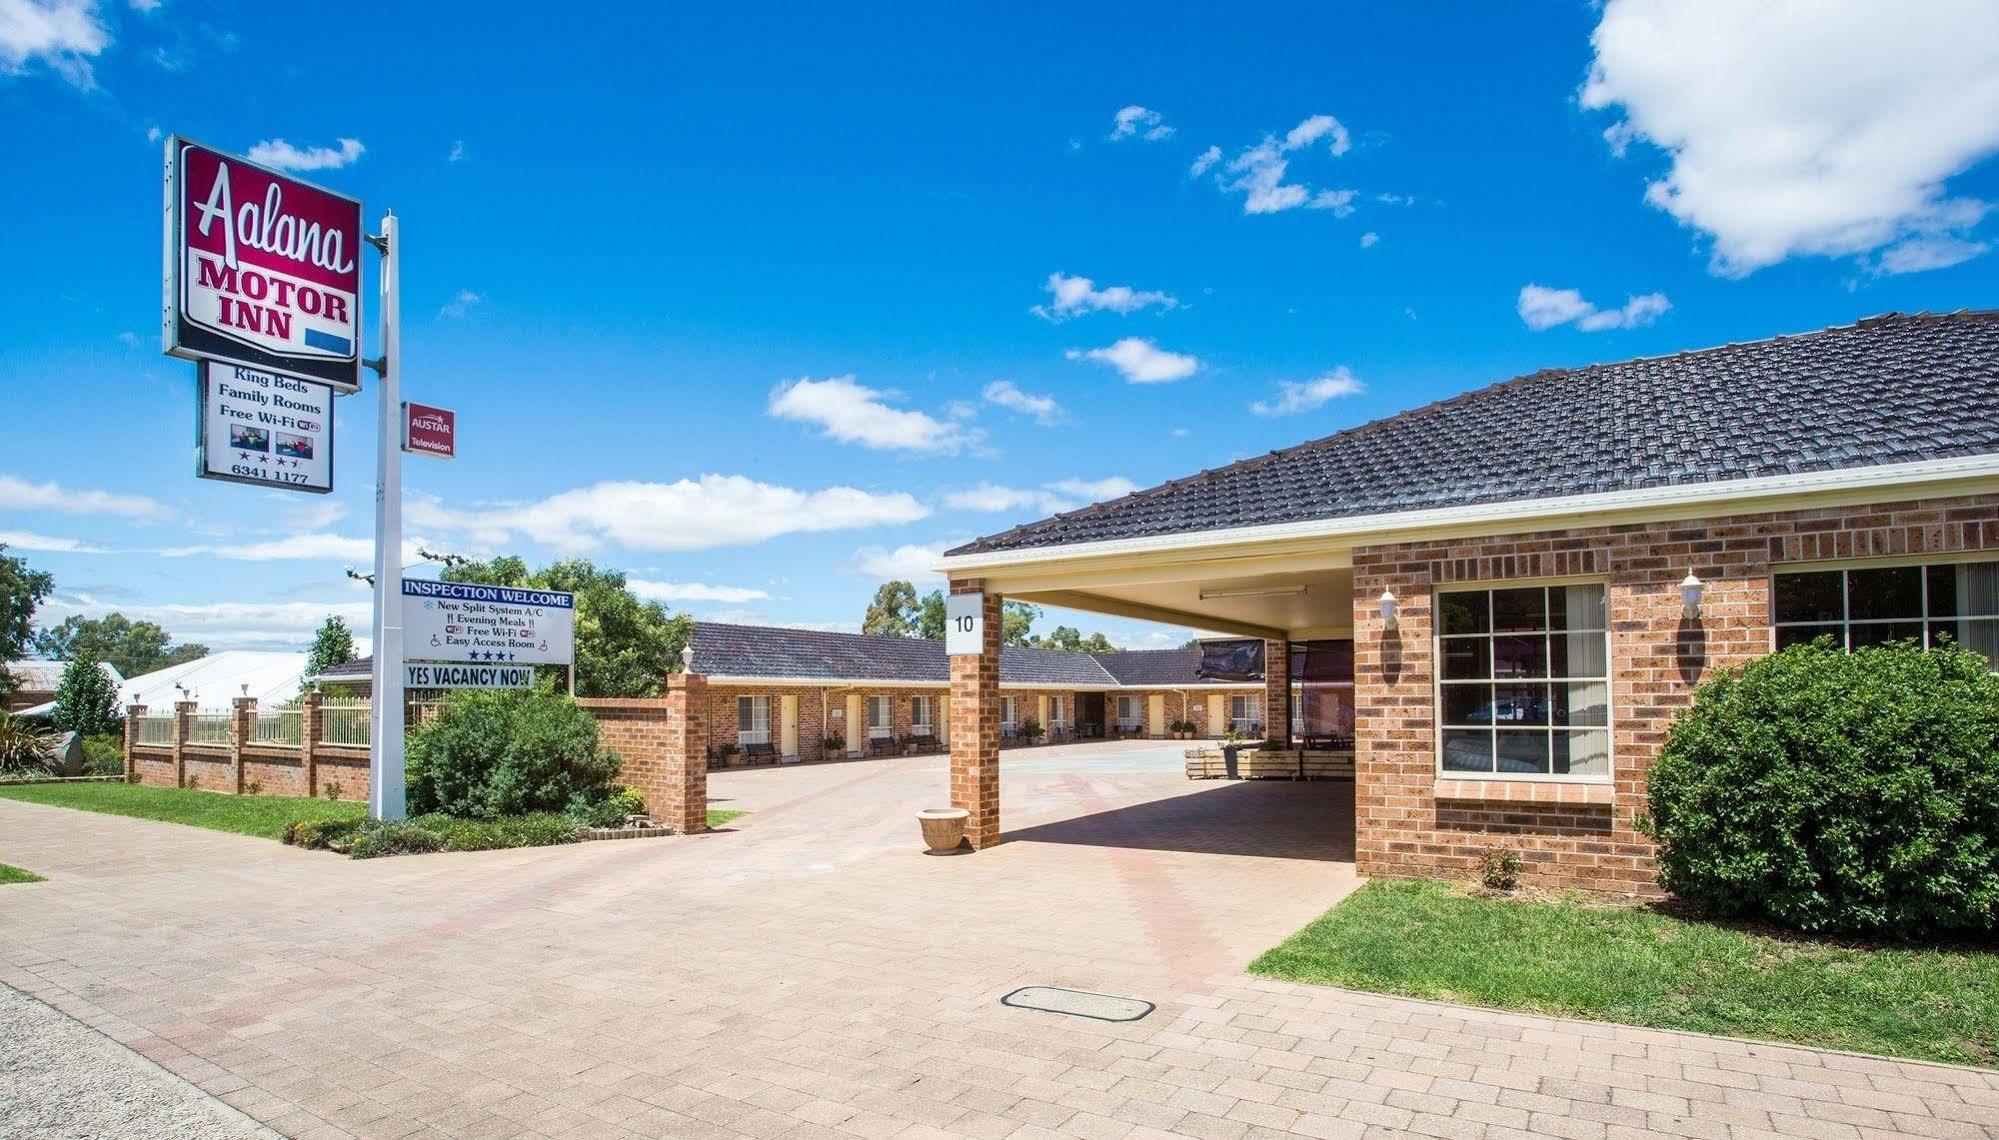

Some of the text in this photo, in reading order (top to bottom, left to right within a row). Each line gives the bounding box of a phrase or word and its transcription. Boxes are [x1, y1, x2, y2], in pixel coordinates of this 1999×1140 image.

[193, 161, 354, 274] Aalana
[198, 256, 349, 324] MOTOR
[218, 296, 292, 341] INN
[234, 367, 308, 394] King Beds
[219, 383, 321, 414] Family Rooms
[220, 404, 253, 420] Free
[258, 411, 295, 428] Wi-Fi
[412, 418, 450, 434] AUSTAR
[411, 437, 451, 452] Television
[231, 464, 308, 483] 6341 1177
[404, 581, 569, 606] INSPECTION WELCOME
[437, 601, 543, 617] New Split System A/C
[457, 614, 526, 627] Evening Meals
[955, 615, 973, 632] 10
[446, 635, 535, 648] Easy Access Room
[467, 627, 489, 635] Free
[493, 629, 517, 638] Wi-Fi
[408, 667, 531, 686] YES VACANCY NOW
